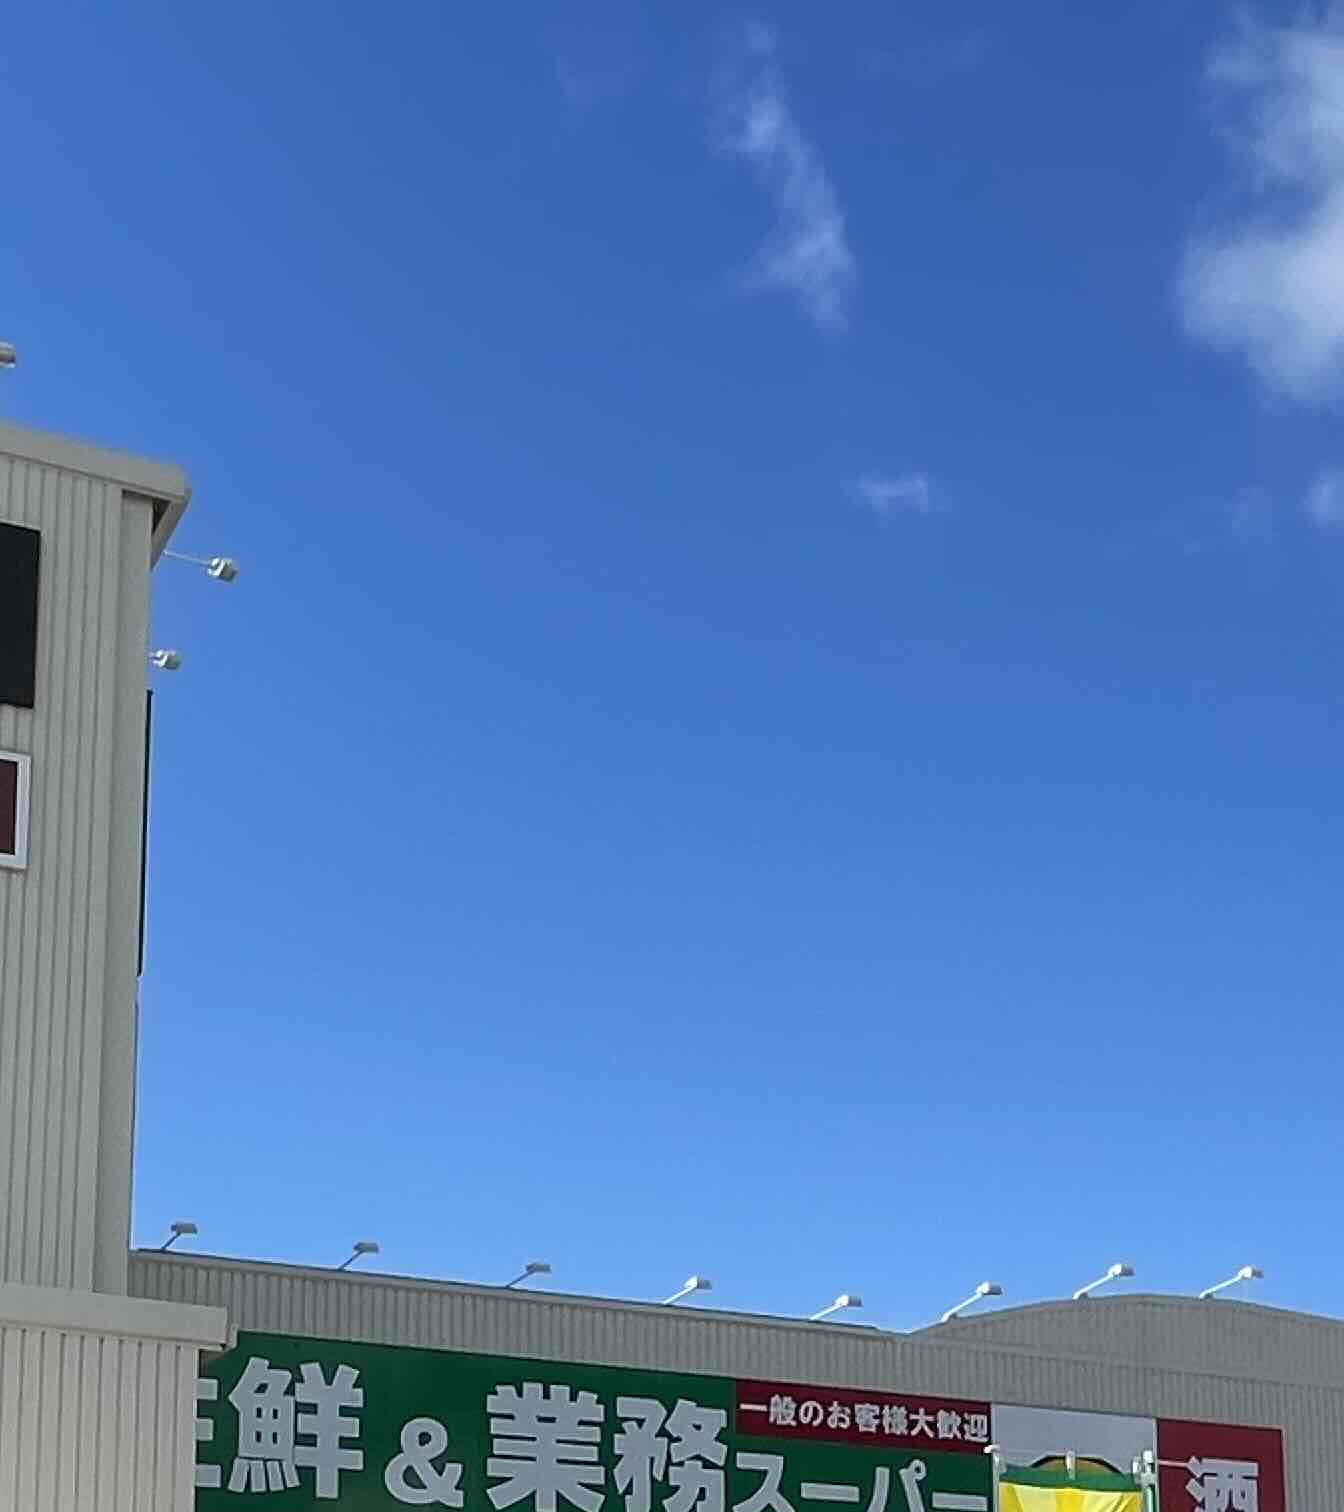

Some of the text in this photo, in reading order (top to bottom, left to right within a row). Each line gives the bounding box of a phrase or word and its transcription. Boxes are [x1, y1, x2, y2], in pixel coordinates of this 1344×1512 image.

[738, 1394, 989, 1444] 一般のお客様大歓迎
